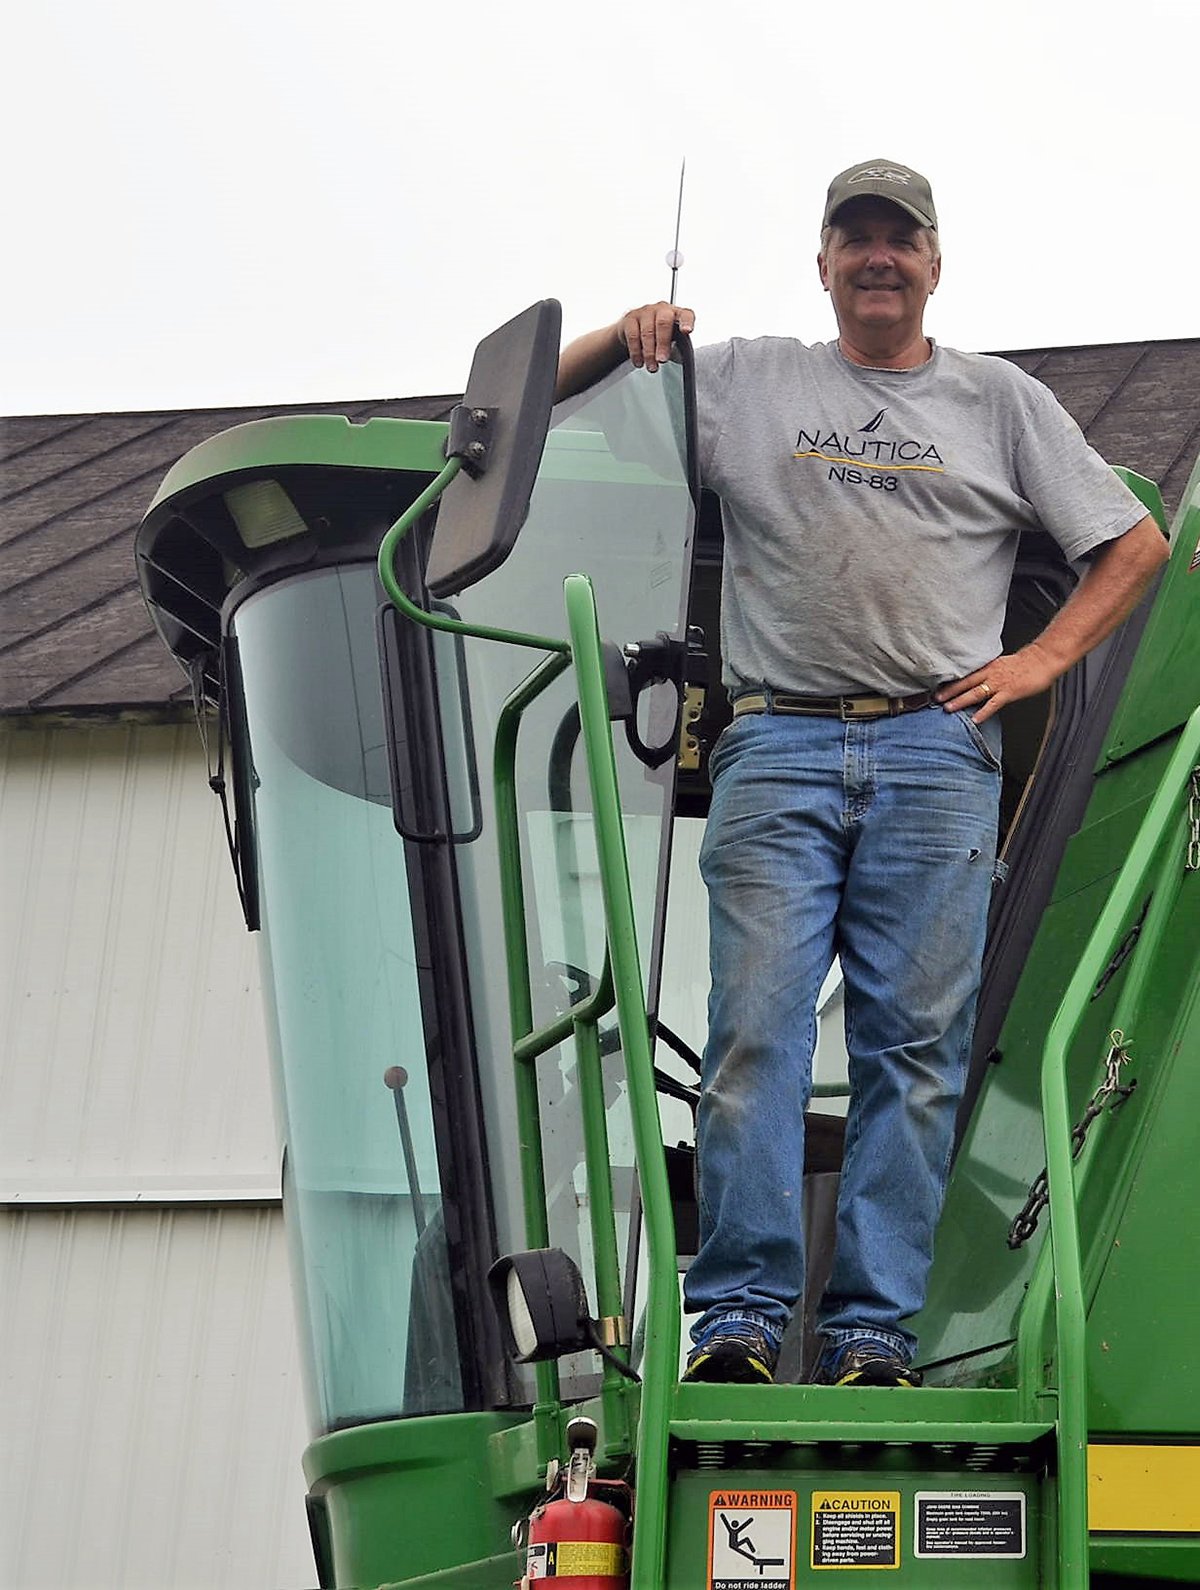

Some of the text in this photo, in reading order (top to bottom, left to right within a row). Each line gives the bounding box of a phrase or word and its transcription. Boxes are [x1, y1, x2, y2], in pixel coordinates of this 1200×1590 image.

[796, 429, 944, 464] NAUTICA
[828, 467, 898, 492] NS-83
[728, 1494, 792, 1506] WARNING
[832, 1499, 890, 1510] CAUTION
[548, 1551, 554, 1565] A
[715, 1581, 786, 1589] Do not ride ladder
